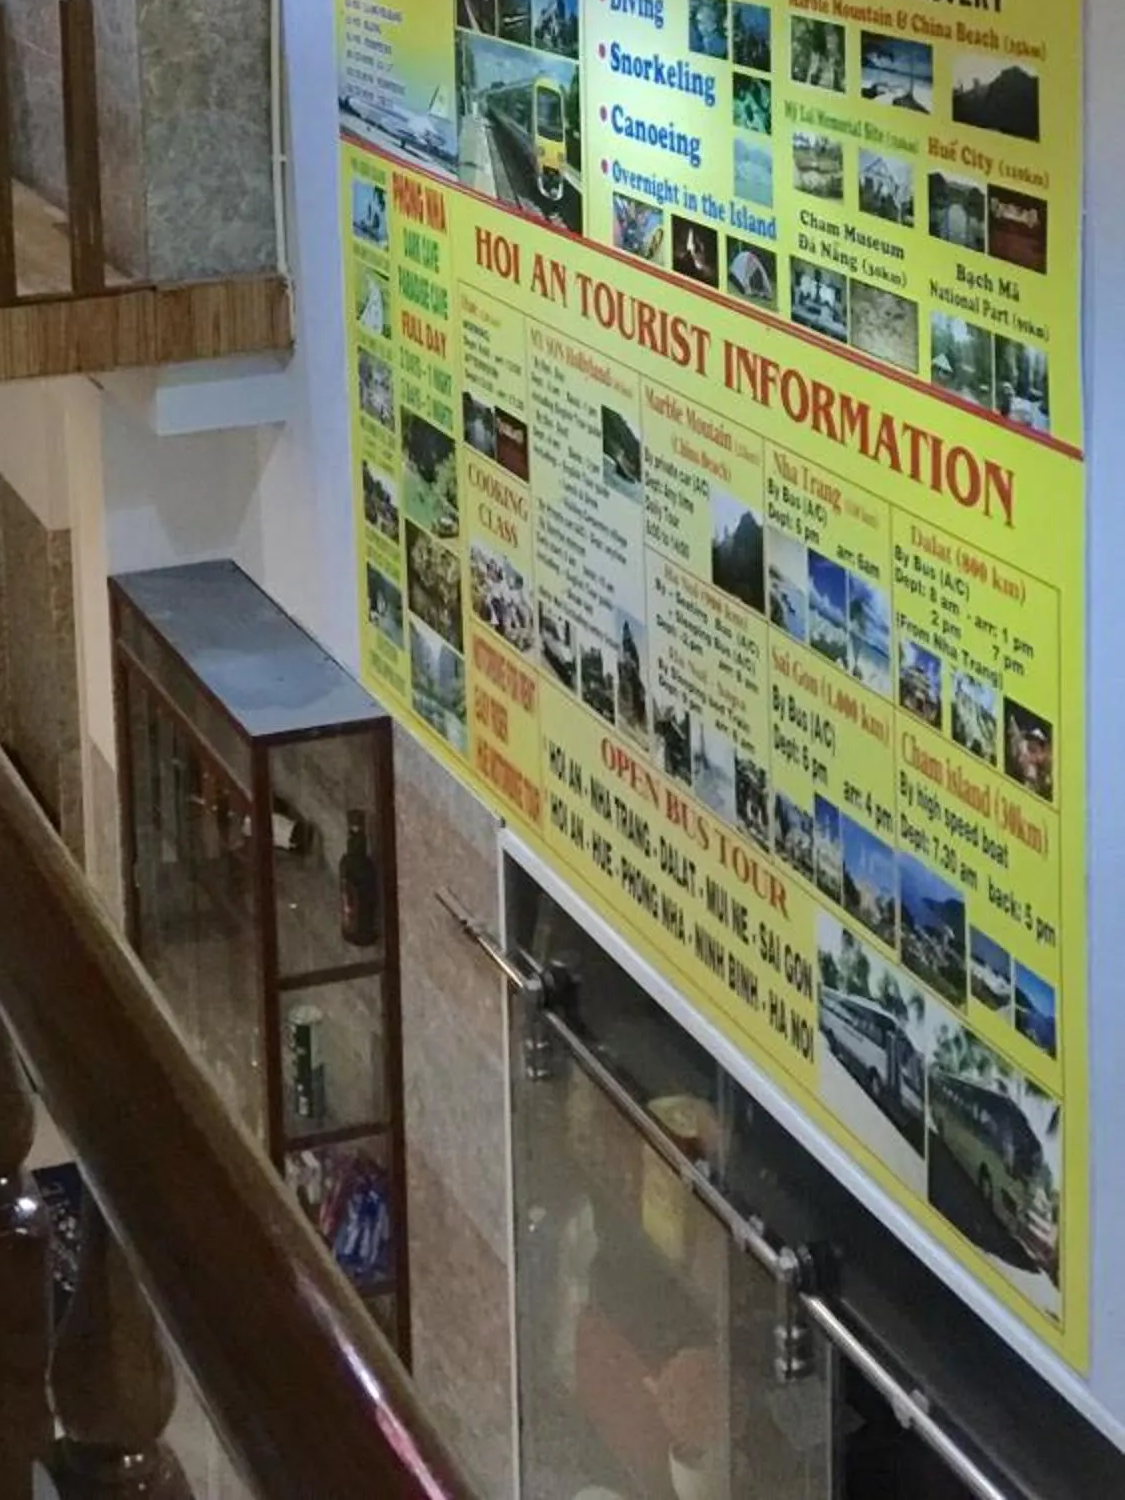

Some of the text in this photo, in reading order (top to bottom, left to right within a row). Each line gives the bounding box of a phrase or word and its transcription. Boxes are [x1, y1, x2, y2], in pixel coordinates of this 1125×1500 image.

[911, 13, 951, 41] China
[956, 21, 999, 50] Beach
[609, 40, 715, 107] Snorkeling
[610, 103, 700, 169] Canoeing
[928, 134, 957, 164] Huế
[961, 144, 993, 176] City
[612, 159, 776, 242] Overnight in the Island
[800, 209, 904, 261] Cham Museum
[930, 279, 980, 316] National
[401, 308, 423, 346] FULL
[425, 322, 445, 359] DAY
[475, 224, 520, 287] HOI
[529, 249, 566, 309] AN
[575, 269, 710, 379] TOURIST
[723, 336, 1014, 529] INFORMATION
[467, 459, 528, 525] COOKING
[773, 449, 797, 485] Nha
[801, 464, 841, 516] Trang
[782, 484, 800, 511] Bus
[478, 500, 517, 550] CLASS
[804, 525, 819, 548] pm
[894, 543, 908, 569] By
[913, 553, 935, 581] Bus
[933, 631, 957, 661] Nha
[941, 594, 958, 617] am
[1013, 633, 1033, 661] pm
[942, 616, 961, 644] pm
[1003, 652, 1024, 681] pm
[772, 682, 807, 733] By Bus
[812, 756, 827, 794] pm
[875, 801, 892, 840] pm
[902, 728, 942, 787] Cham
[945, 756, 990, 819] island
[600, 734, 658, 812] OPEN
[665, 786, 708, 854] BUS
[715, 826, 789, 920] TOUR
[900, 768, 912, 808] By
[944, 800, 978, 855] speed
[982, 824, 1008, 871] boat
[549, 737, 566, 784] HOI
[568, 755, 582, 797] AN
[614, 795, 650, 860] TRANG
[659, 833, 695, 900] DALAT
[731, 894, 748, 946] NE
[759, 917, 780, 973] SAI
[784, 939, 812, 1001] GON
[550, 790, 567, 839] HOI
[570, 808, 584, 854] AN
[592, 827, 613, 880] HUE
[621, 853, 658, 922] PHONG
[769, 985, 787, 1041] HA
[960, 859, 977, 892] am
[1036, 915, 1055, 955] pm
